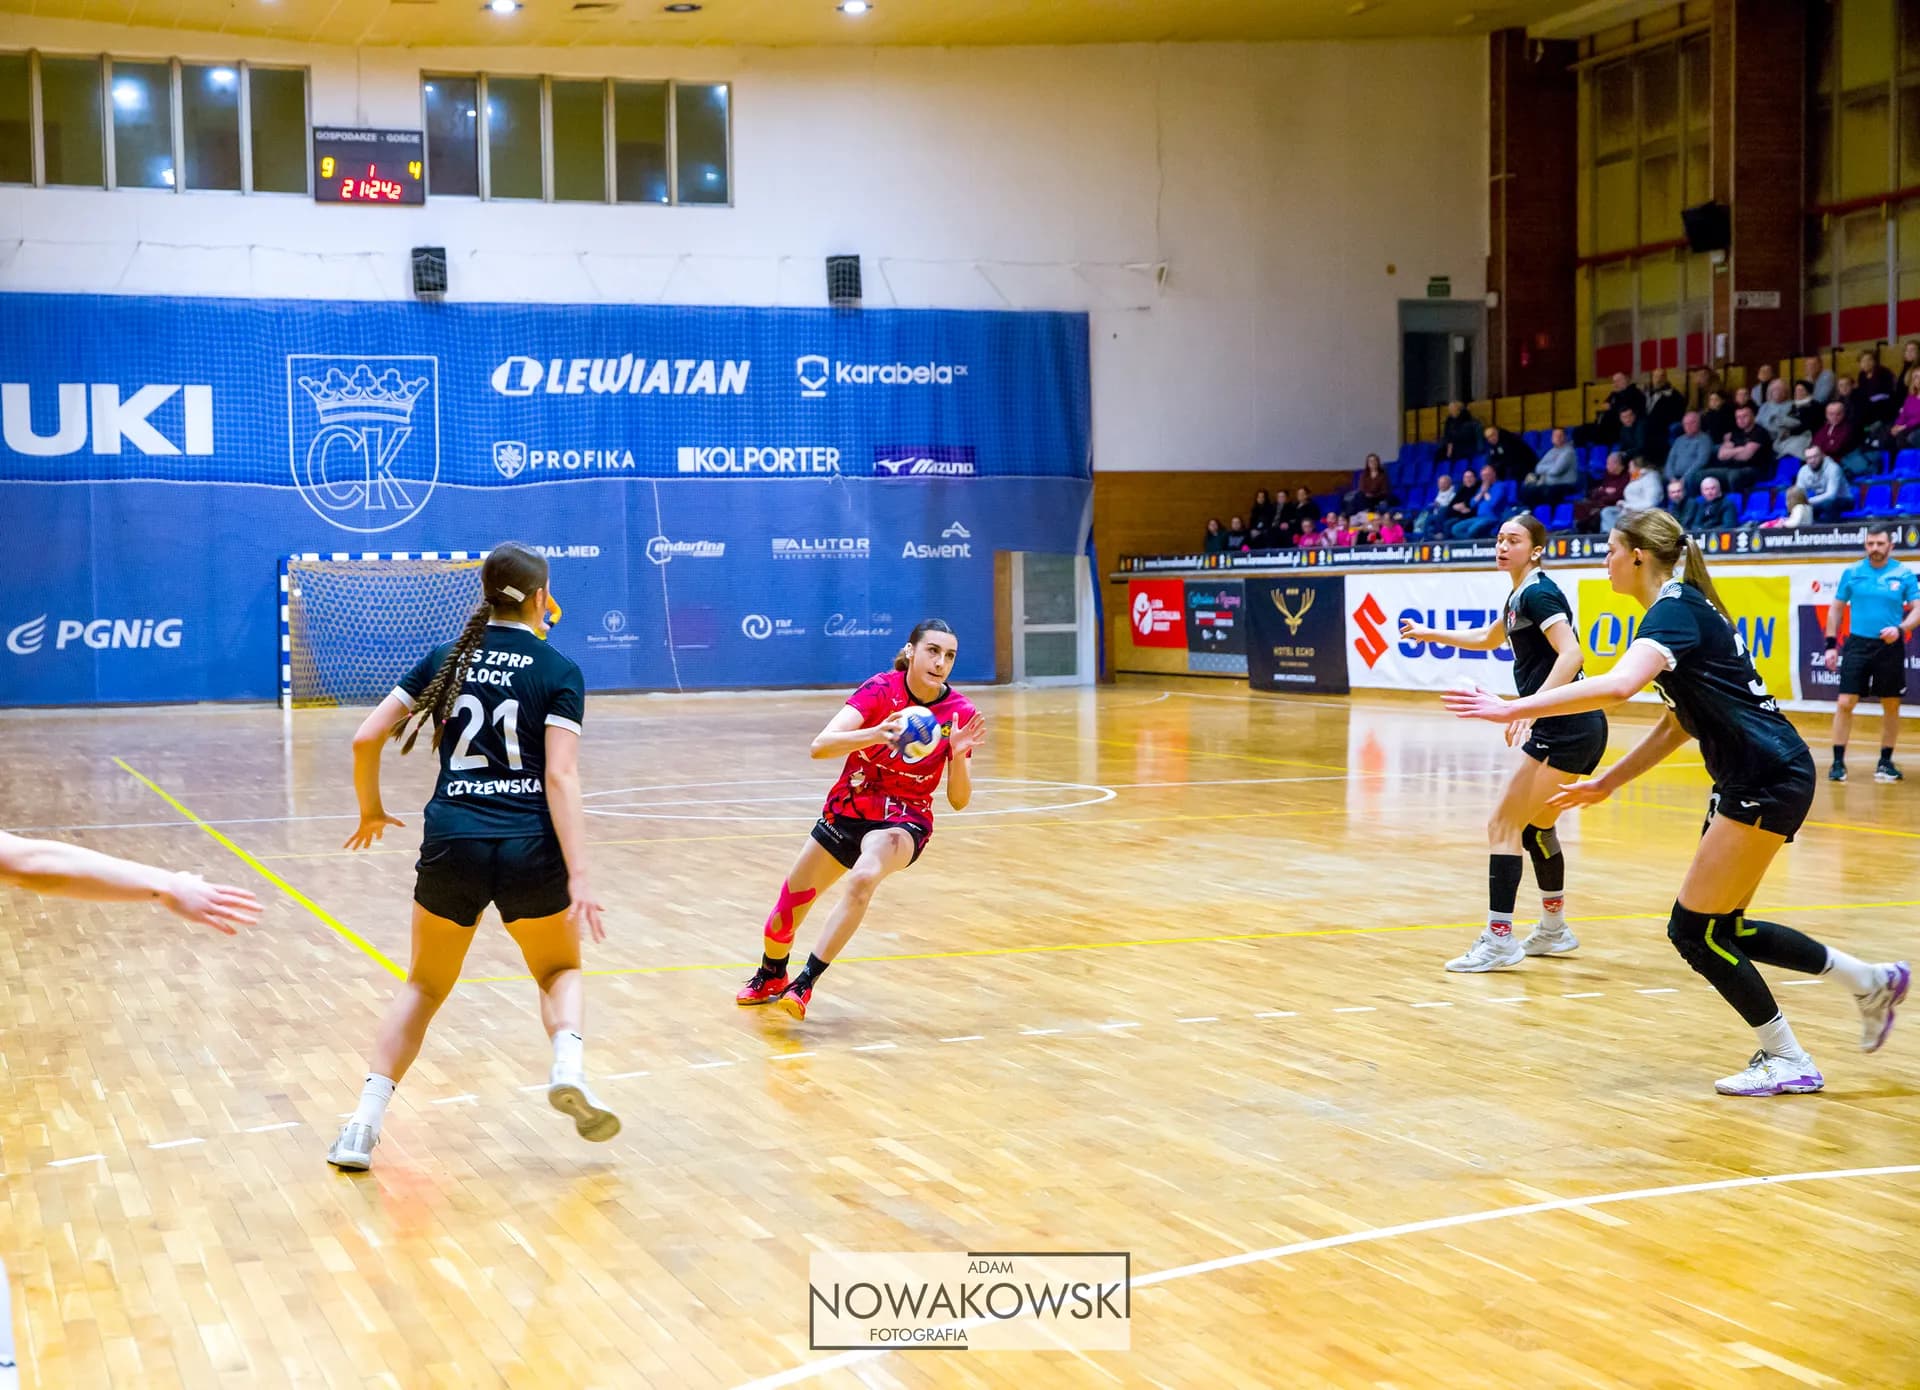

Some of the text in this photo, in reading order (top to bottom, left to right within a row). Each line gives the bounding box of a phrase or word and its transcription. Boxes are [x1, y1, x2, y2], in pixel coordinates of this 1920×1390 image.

[321, 156, 336, 178] 9
[408, 160, 422, 180] 4
[545, 352, 751, 395] LEWIATAN
[835, 360, 953, 384] karabela
[1, 383, 213, 456] UKI
[530, 450, 636, 470] PROFIKA
[694, 446, 840, 473] KOLPORTER
[530, 546, 600, 557] RAL-MED
[785, 538, 870, 549] ALUTOR
[902, 541, 971, 558] Aswent
[56, 618, 183, 650] PGNiG
[485, 651, 534, 669] ZPRP
[449, 693, 524, 771] 21
[446, 778, 543, 797] CZYŻEWSKA
